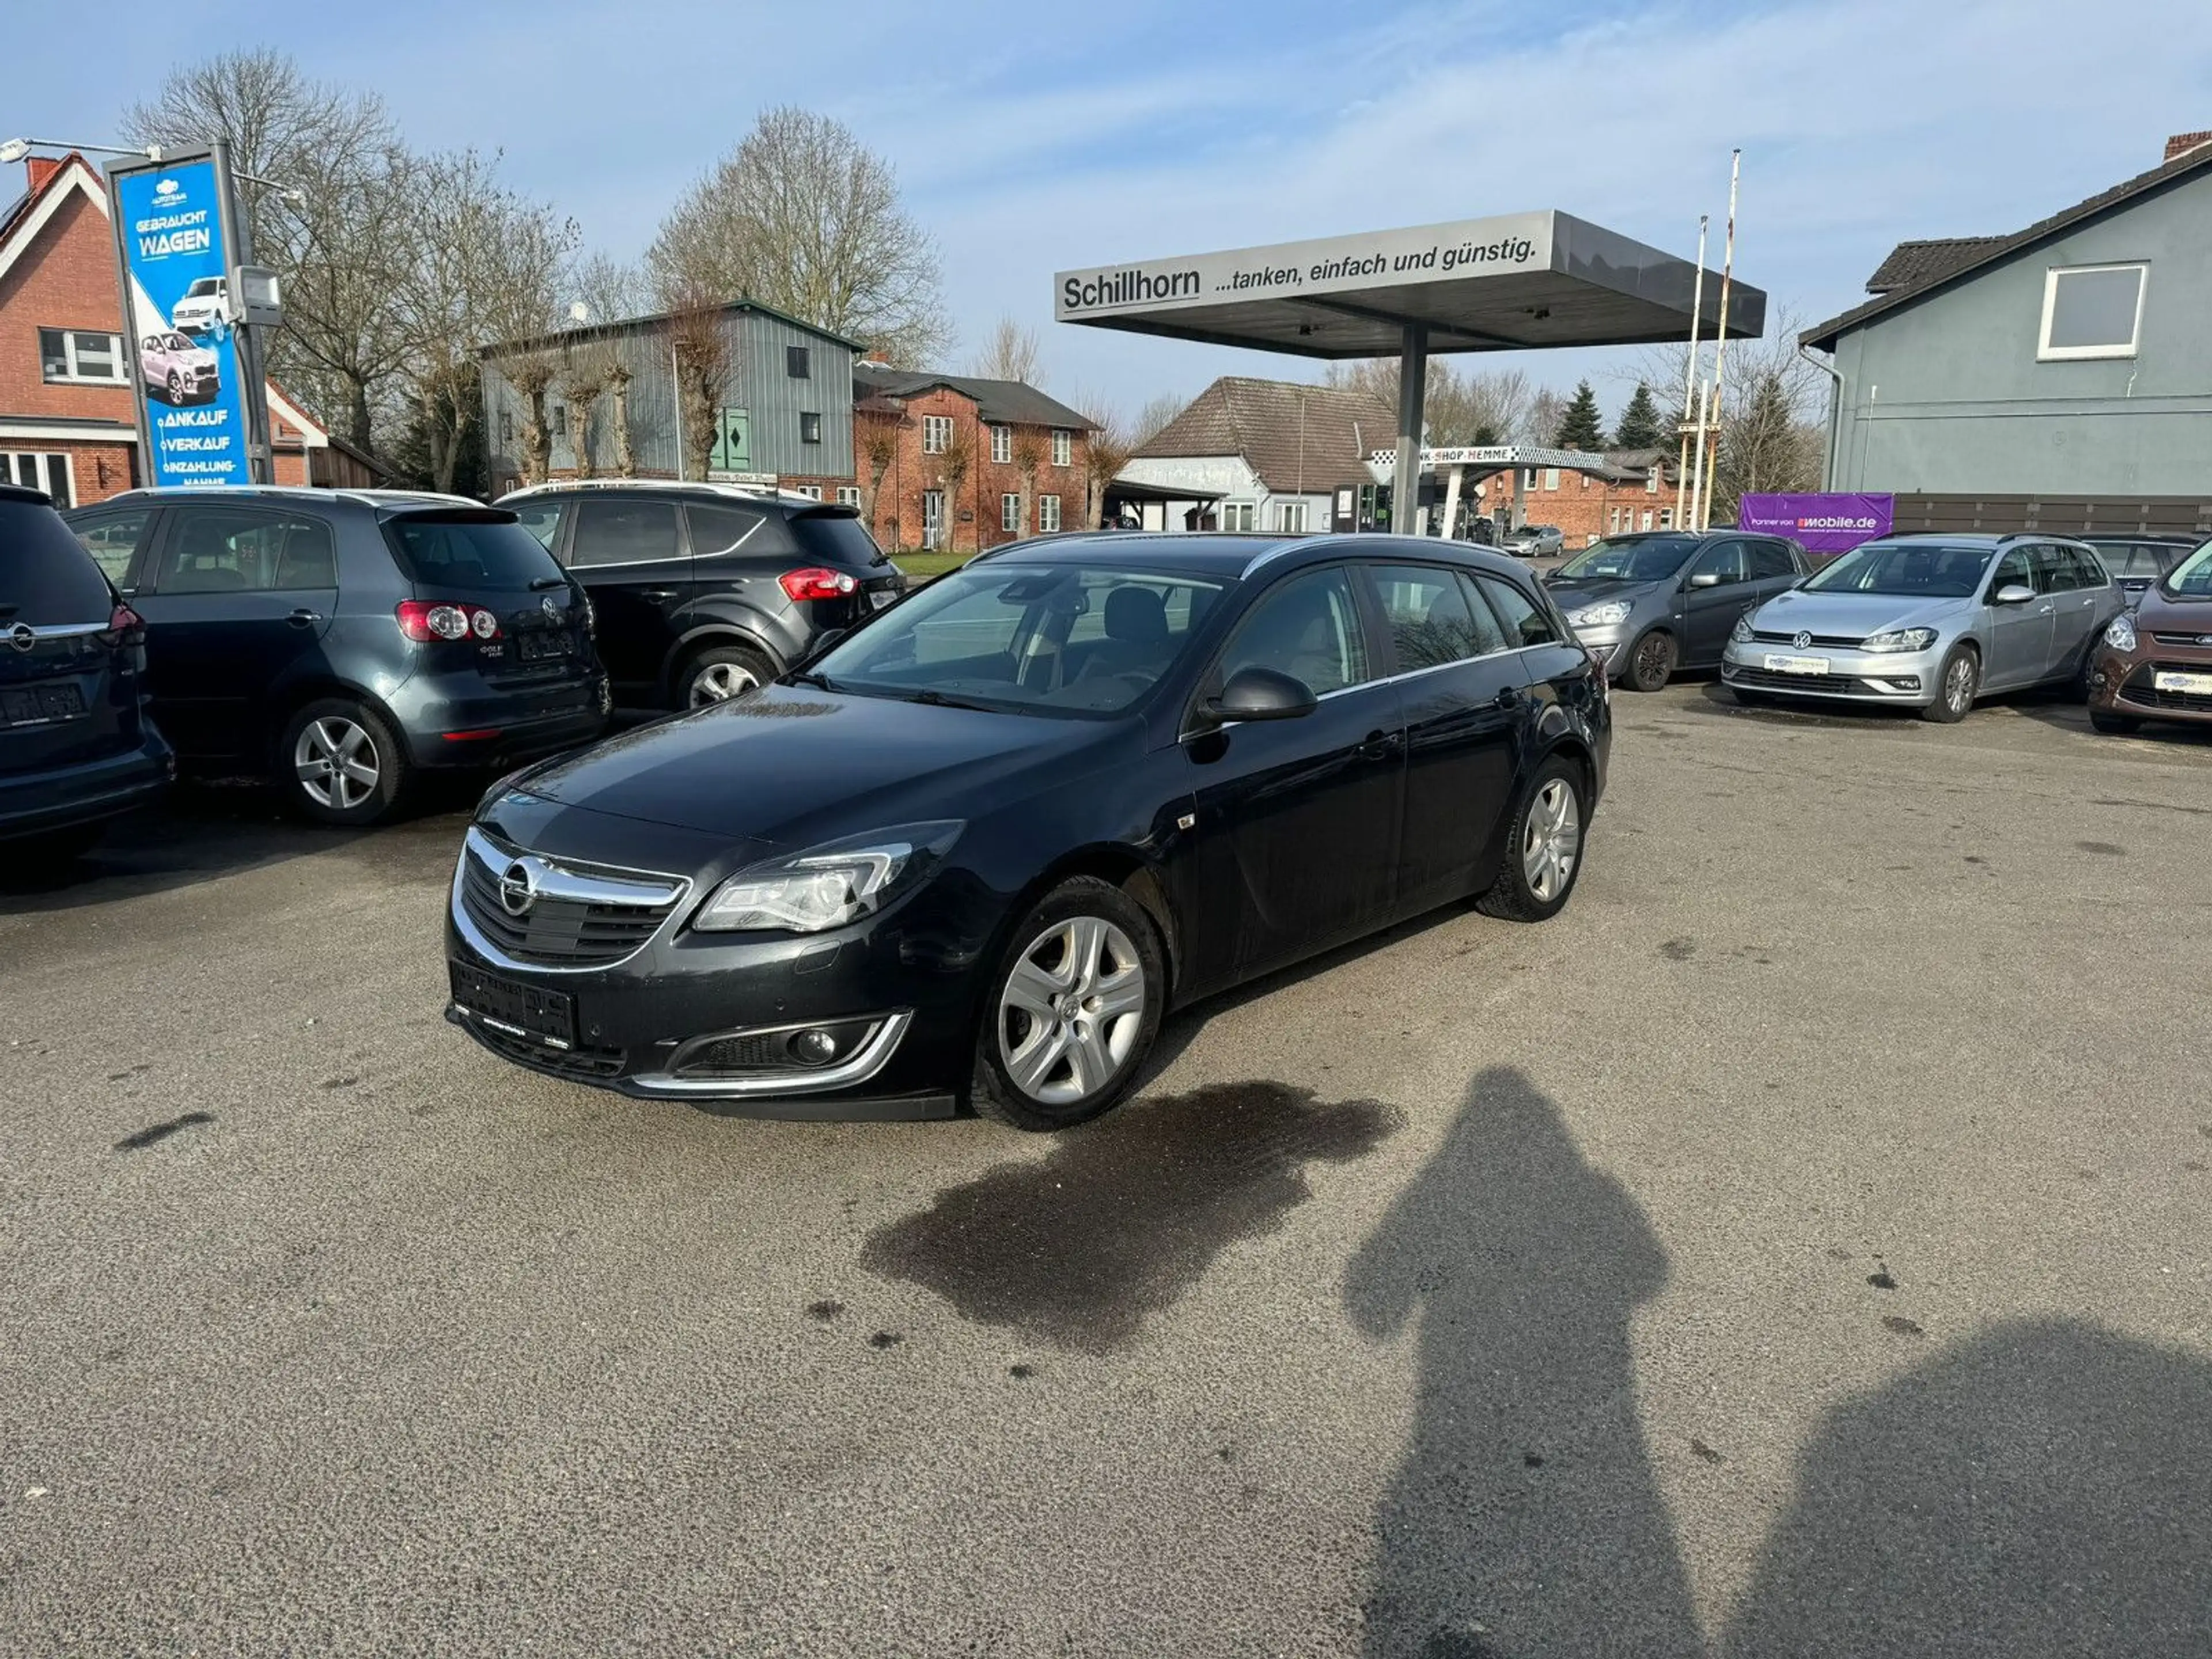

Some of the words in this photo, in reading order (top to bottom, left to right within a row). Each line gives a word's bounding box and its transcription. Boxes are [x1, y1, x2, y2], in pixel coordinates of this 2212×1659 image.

[136, 210, 207, 233] GEBRAUCHT
[139, 228, 210, 257] WAGEN
[1065, 270, 1200, 308] Schillhorn
[1215, 266, 1302, 291] ...tanken,
[1310, 253, 1387, 281] einfach
[1393, 246, 1438, 271] und
[1442, 237, 1536, 271] günstig.
[165, 409, 228, 427] ANKAUF
[166, 437, 230, 452] VERKAUF
[1751, 518, 1779, 526] Partner
[1804, 516, 1877, 528] mobile.de
